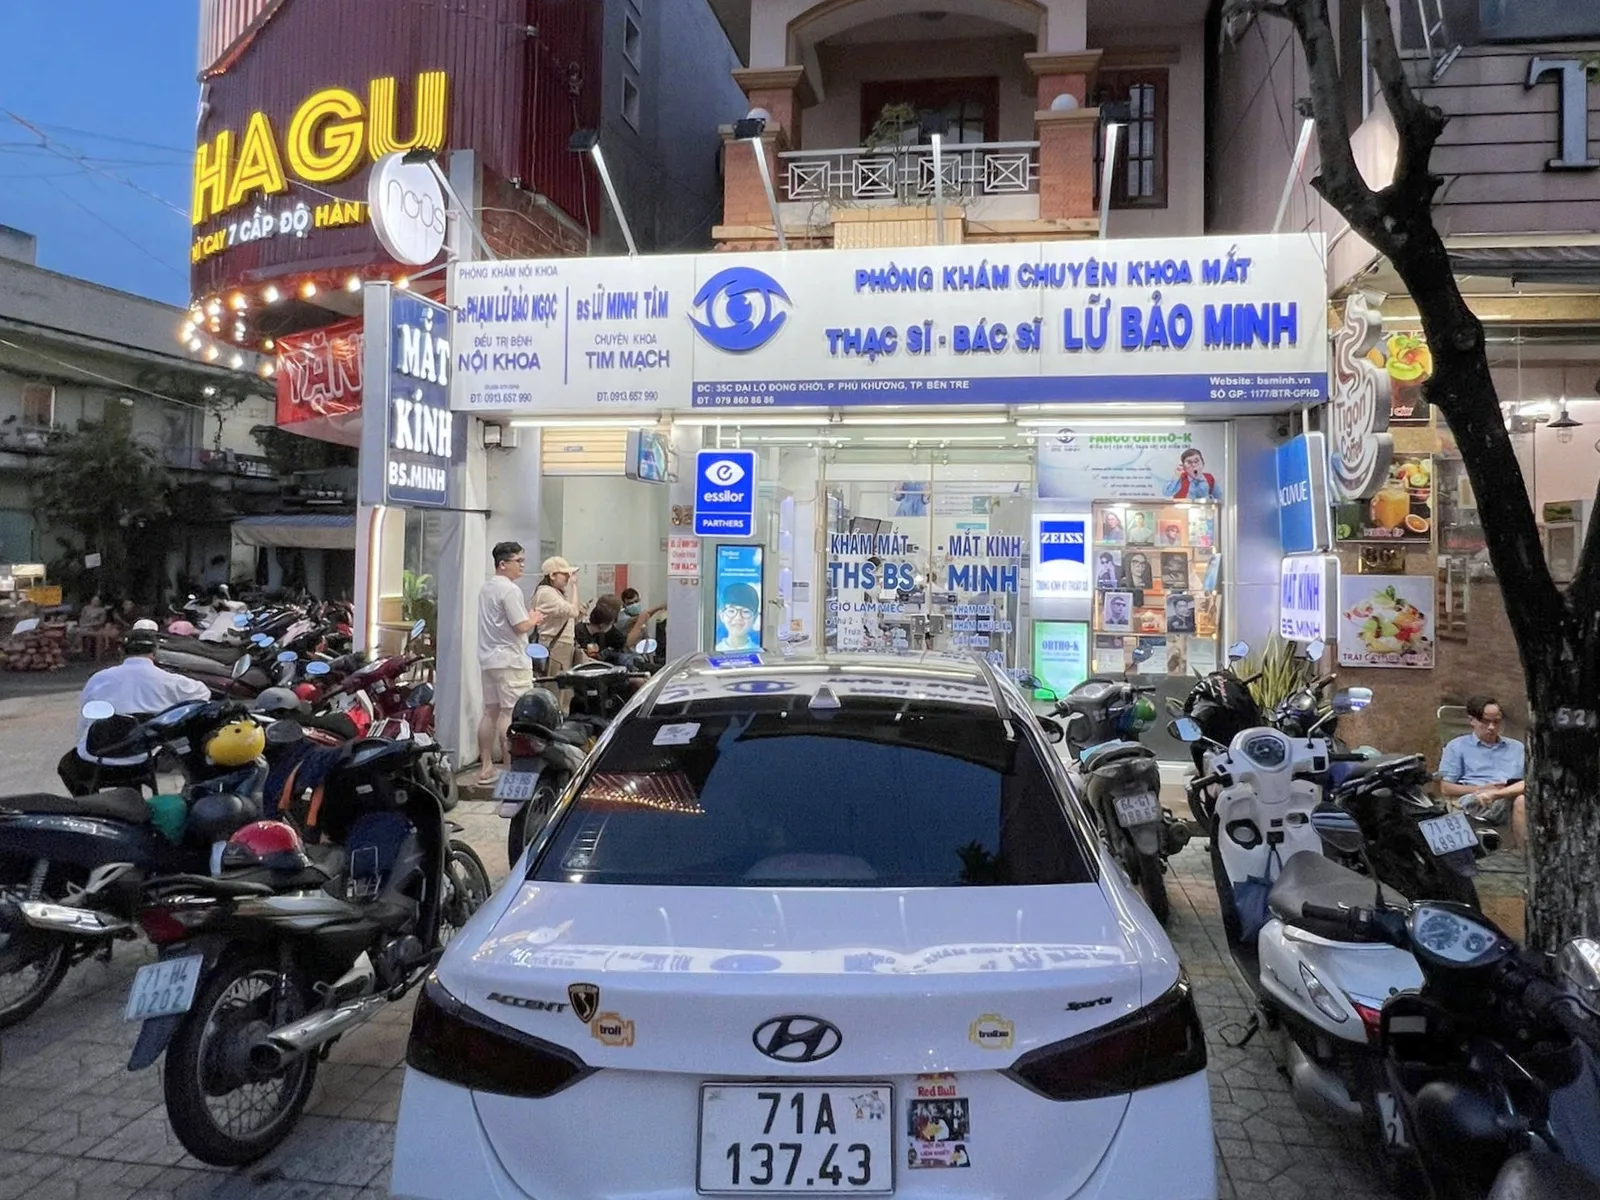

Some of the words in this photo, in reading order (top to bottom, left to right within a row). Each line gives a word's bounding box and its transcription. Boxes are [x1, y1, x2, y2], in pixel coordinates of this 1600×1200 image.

[193, 72, 447, 225] HAGU
[203, 229, 226, 254] CAY
[228, 223, 237, 245] 7
[280, 203, 309, 237] ĐỘ
[491, 265, 516, 278] KHÁM
[535, 265, 558, 277] KHOA
[855, 261, 933, 293] PHÒNG
[942, 259, 1010, 291] KHÁM
[1017, 256, 1117, 288] CHUYÊN
[1127, 259, 1192, 286] KHOA
[1202, 244, 1252, 284] MẮT
[532, 292, 557, 328] NGỌC
[576, 299, 590, 320] BS
[606, 291, 638, 319] MINH
[643, 285, 668, 318] TÂM
[633, 334, 657, 345] KHOA
[825, 326, 898, 362] THẠC
[907, 320, 933, 355] SĨ
[953, 317, 1007, 355] BÁC
[1016, 317, 1043, 351] SĨ
[1063, 293, 1110, 351] LỮ
[1120, 290, 1193, 351] BẢO
[1203, 301, 1297, 350] MINH
[397, 307, 450, 386] MẮT
[287, 331, 364, 414] TẶN
[458, 349, 487, 374] NỘI
[493, 352, 541, 370] KHOA
[585, 351, 614, 369] TIM
[619, 349, 670, 372] MẠCH
[716, 383, 733, 392] 35C
[949, 380, 969, 389] TRE
[1210, 376, 1254, 385] Website:
[1256, 376, 1311, 385] bsminh.vn
[1228, 390, 1247, 398] GP:
[715, 396, 731, 404] 079
[733, 396, 749, 404] 860
[393, 388, 453, 458] KÍNH
[1336, 393, 1366, 437] Tigon
[388, 461, 446, 491] BS.MINH
[703, 490, 744, 503] essilor
[702, 519, 744, 528] PARTNERS
[831, 528, 872, 555] KHÁM
[877, 527, 908, 555] MẮT
[949, 528, 981, 556] MẮT
[986, 529, 1021, 558] KÍNH
[1040, 532, 1084, 544] ZEISS
[948, 565, 1017, 592] MINH
[486, 992, 569, 1013] ACCENT
[600, 1024, 621, 1035] troll
[918, 1085, 936, 1096] Red
[937, 1085, 956, 1096] Bull
[758, 1092, 837, 1135] 71A
[726, 1142, 870, 1186] 137.43
